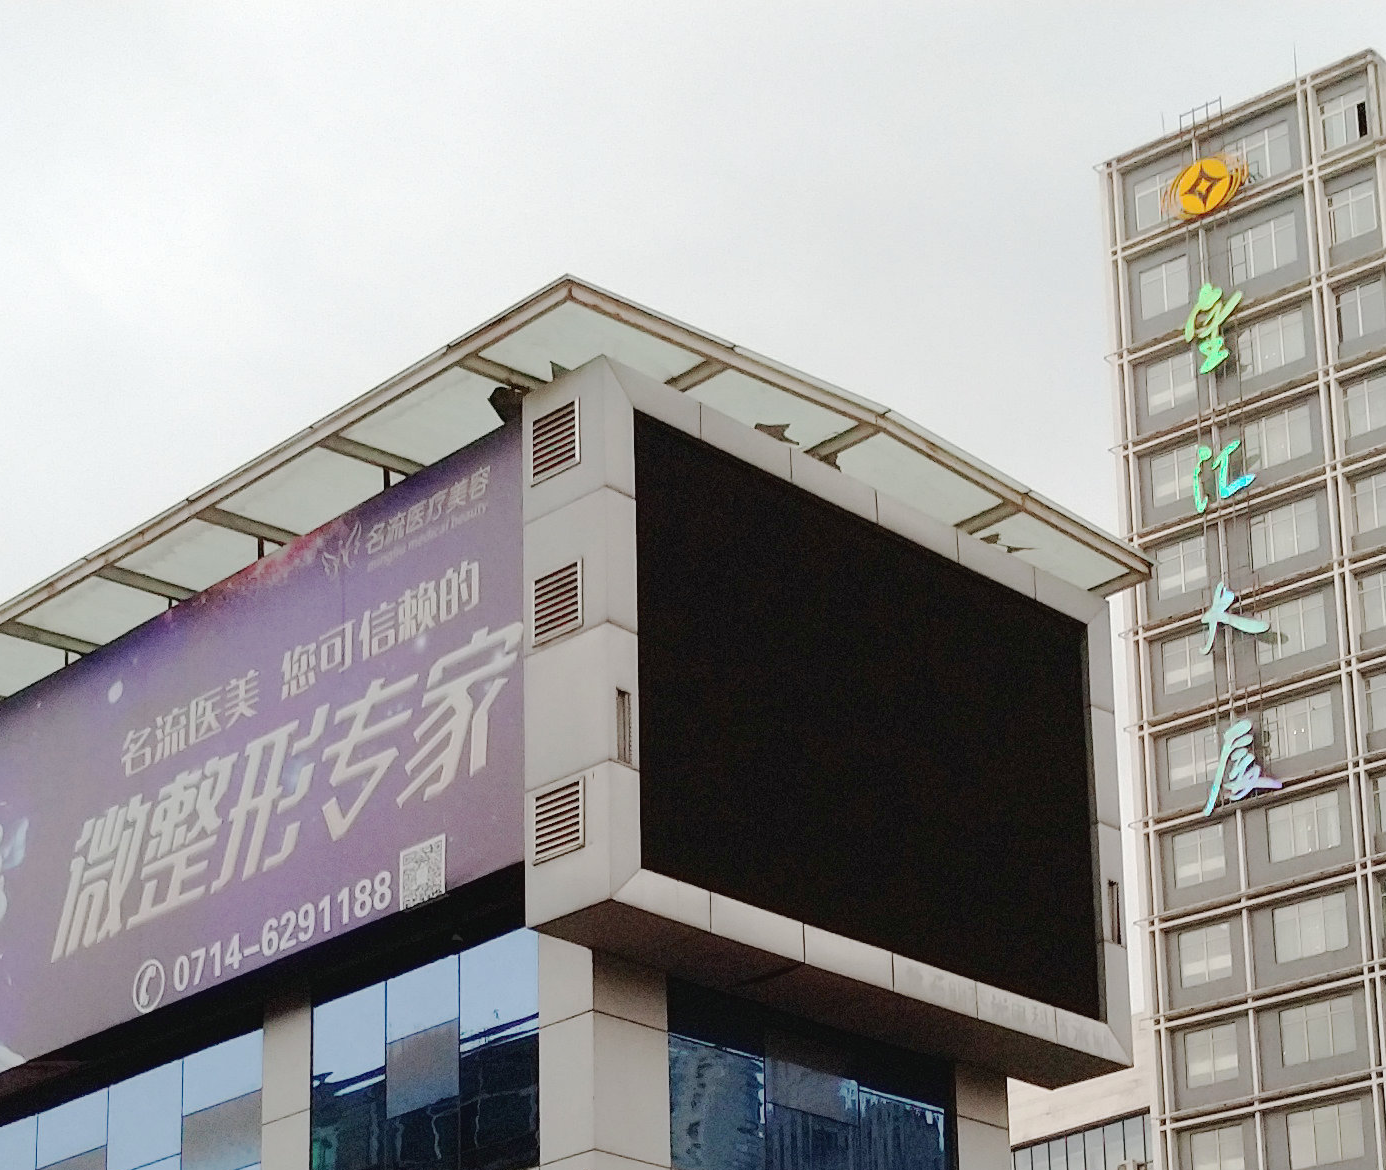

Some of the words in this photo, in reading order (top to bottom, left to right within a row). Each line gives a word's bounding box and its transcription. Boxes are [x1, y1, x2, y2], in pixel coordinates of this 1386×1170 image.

[366, 465, 491, 554] 名流医疗美容
[121, 668, 260, 778] 名流医美
[280, 560, 481, 700] 您可信赖的
[51, 619, 524, 964] 微整形专家
[173, 870, 392, 992] 0714-6291188
